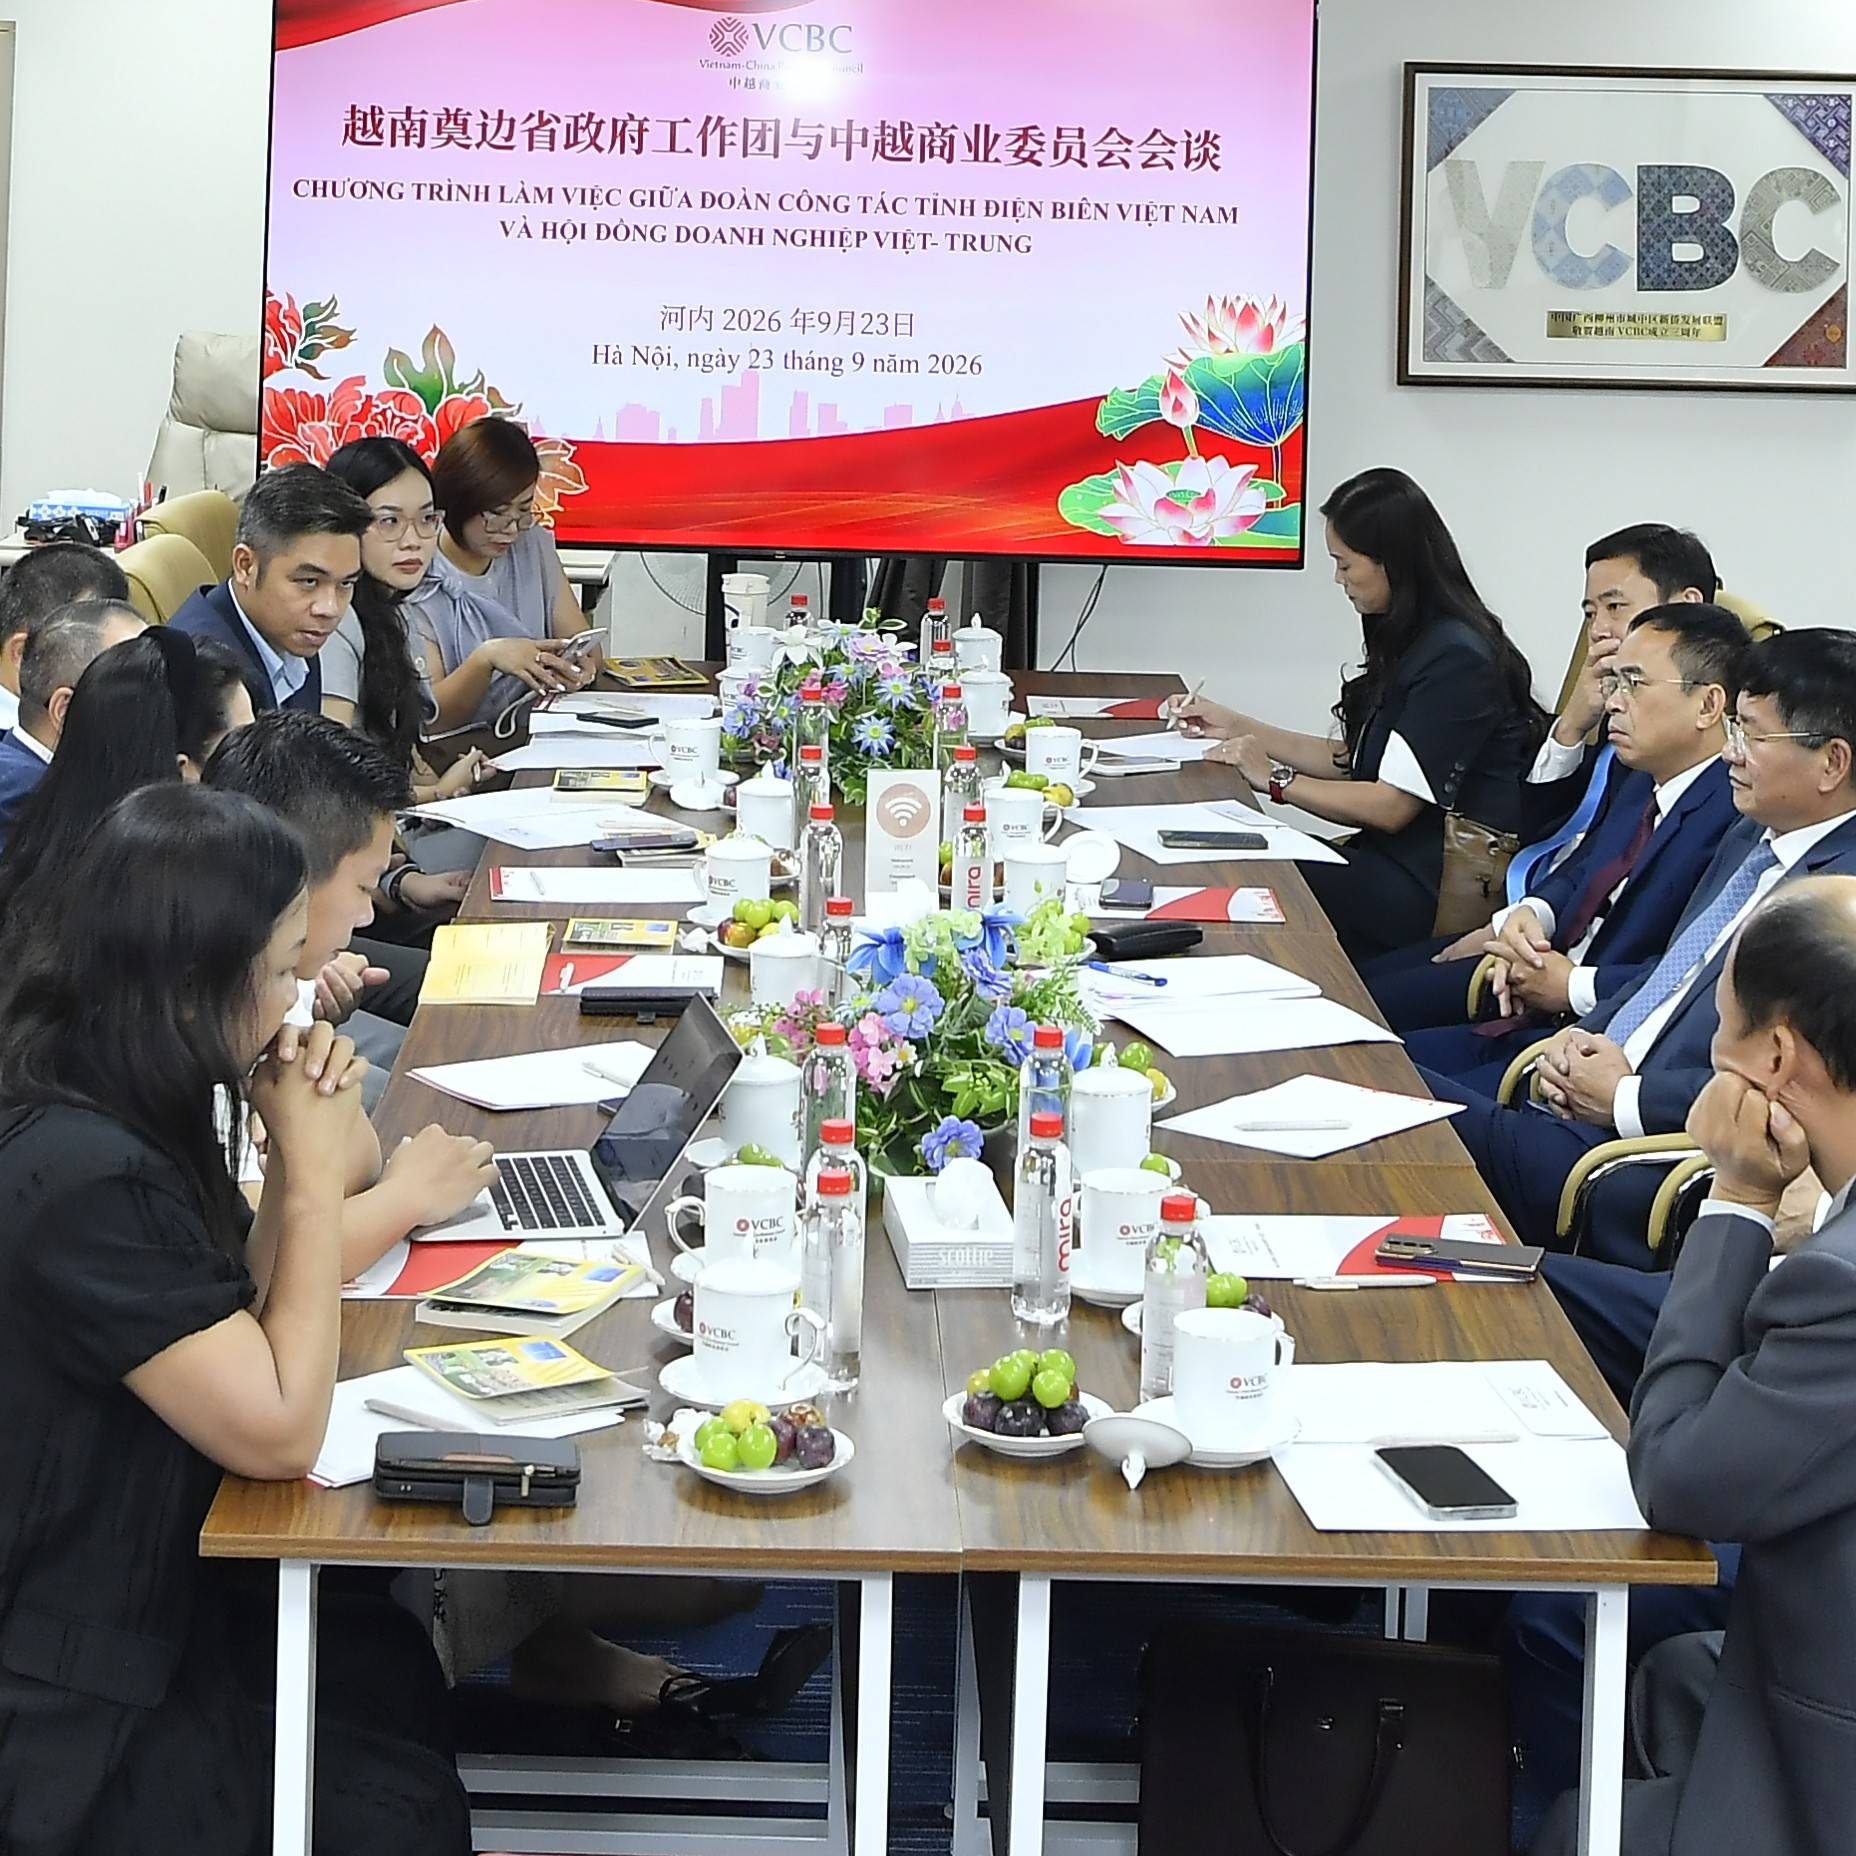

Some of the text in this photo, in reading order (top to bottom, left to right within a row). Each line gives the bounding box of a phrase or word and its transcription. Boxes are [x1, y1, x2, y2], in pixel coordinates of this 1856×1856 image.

[752, 23, 853, 54] VCBC
[342, 103, 1222, 173] 越南奠边省政府工作团与中越商业委员会会谈
[292, 178, 405, 202] CHƯƠNG
[411, 181, 490, 204] TRÌNH
[499, 181, 555, 207] LÀM
[561, 187, 622, 212] VIỆC
[629, 187, 694, 210] GIỮA
[700, 189, 771, 212] ĐOÀN
[778, 189, 851, 215] CÔNG
[857, 191, 908, 216] TÁC
[983, 197, 1044, 224] ĐIỆN
[1050, 197, 1110, 222] BIÊN
[1116, 200, 1175, 227] VIỆT
[1181, 204, 1239, 225] NAM
[500, 216, 1032, 255] VÀ HỘI ĐỒNG DOANH NGHIỆP VIỆT- TRUNG
[1444, 159, 1842, 294] VCBC
[660, 304, 914, 338] 河内 2026 年9月23日
[591, 344, 983, 377] Hà Nội, ngày 23 tháng 9 năm 2026
[751, 1217, 784, 1230] VCBC
[1132, 1224, 1157, 1235] VCB
[707, 1327, 736, 1340] VCBC
